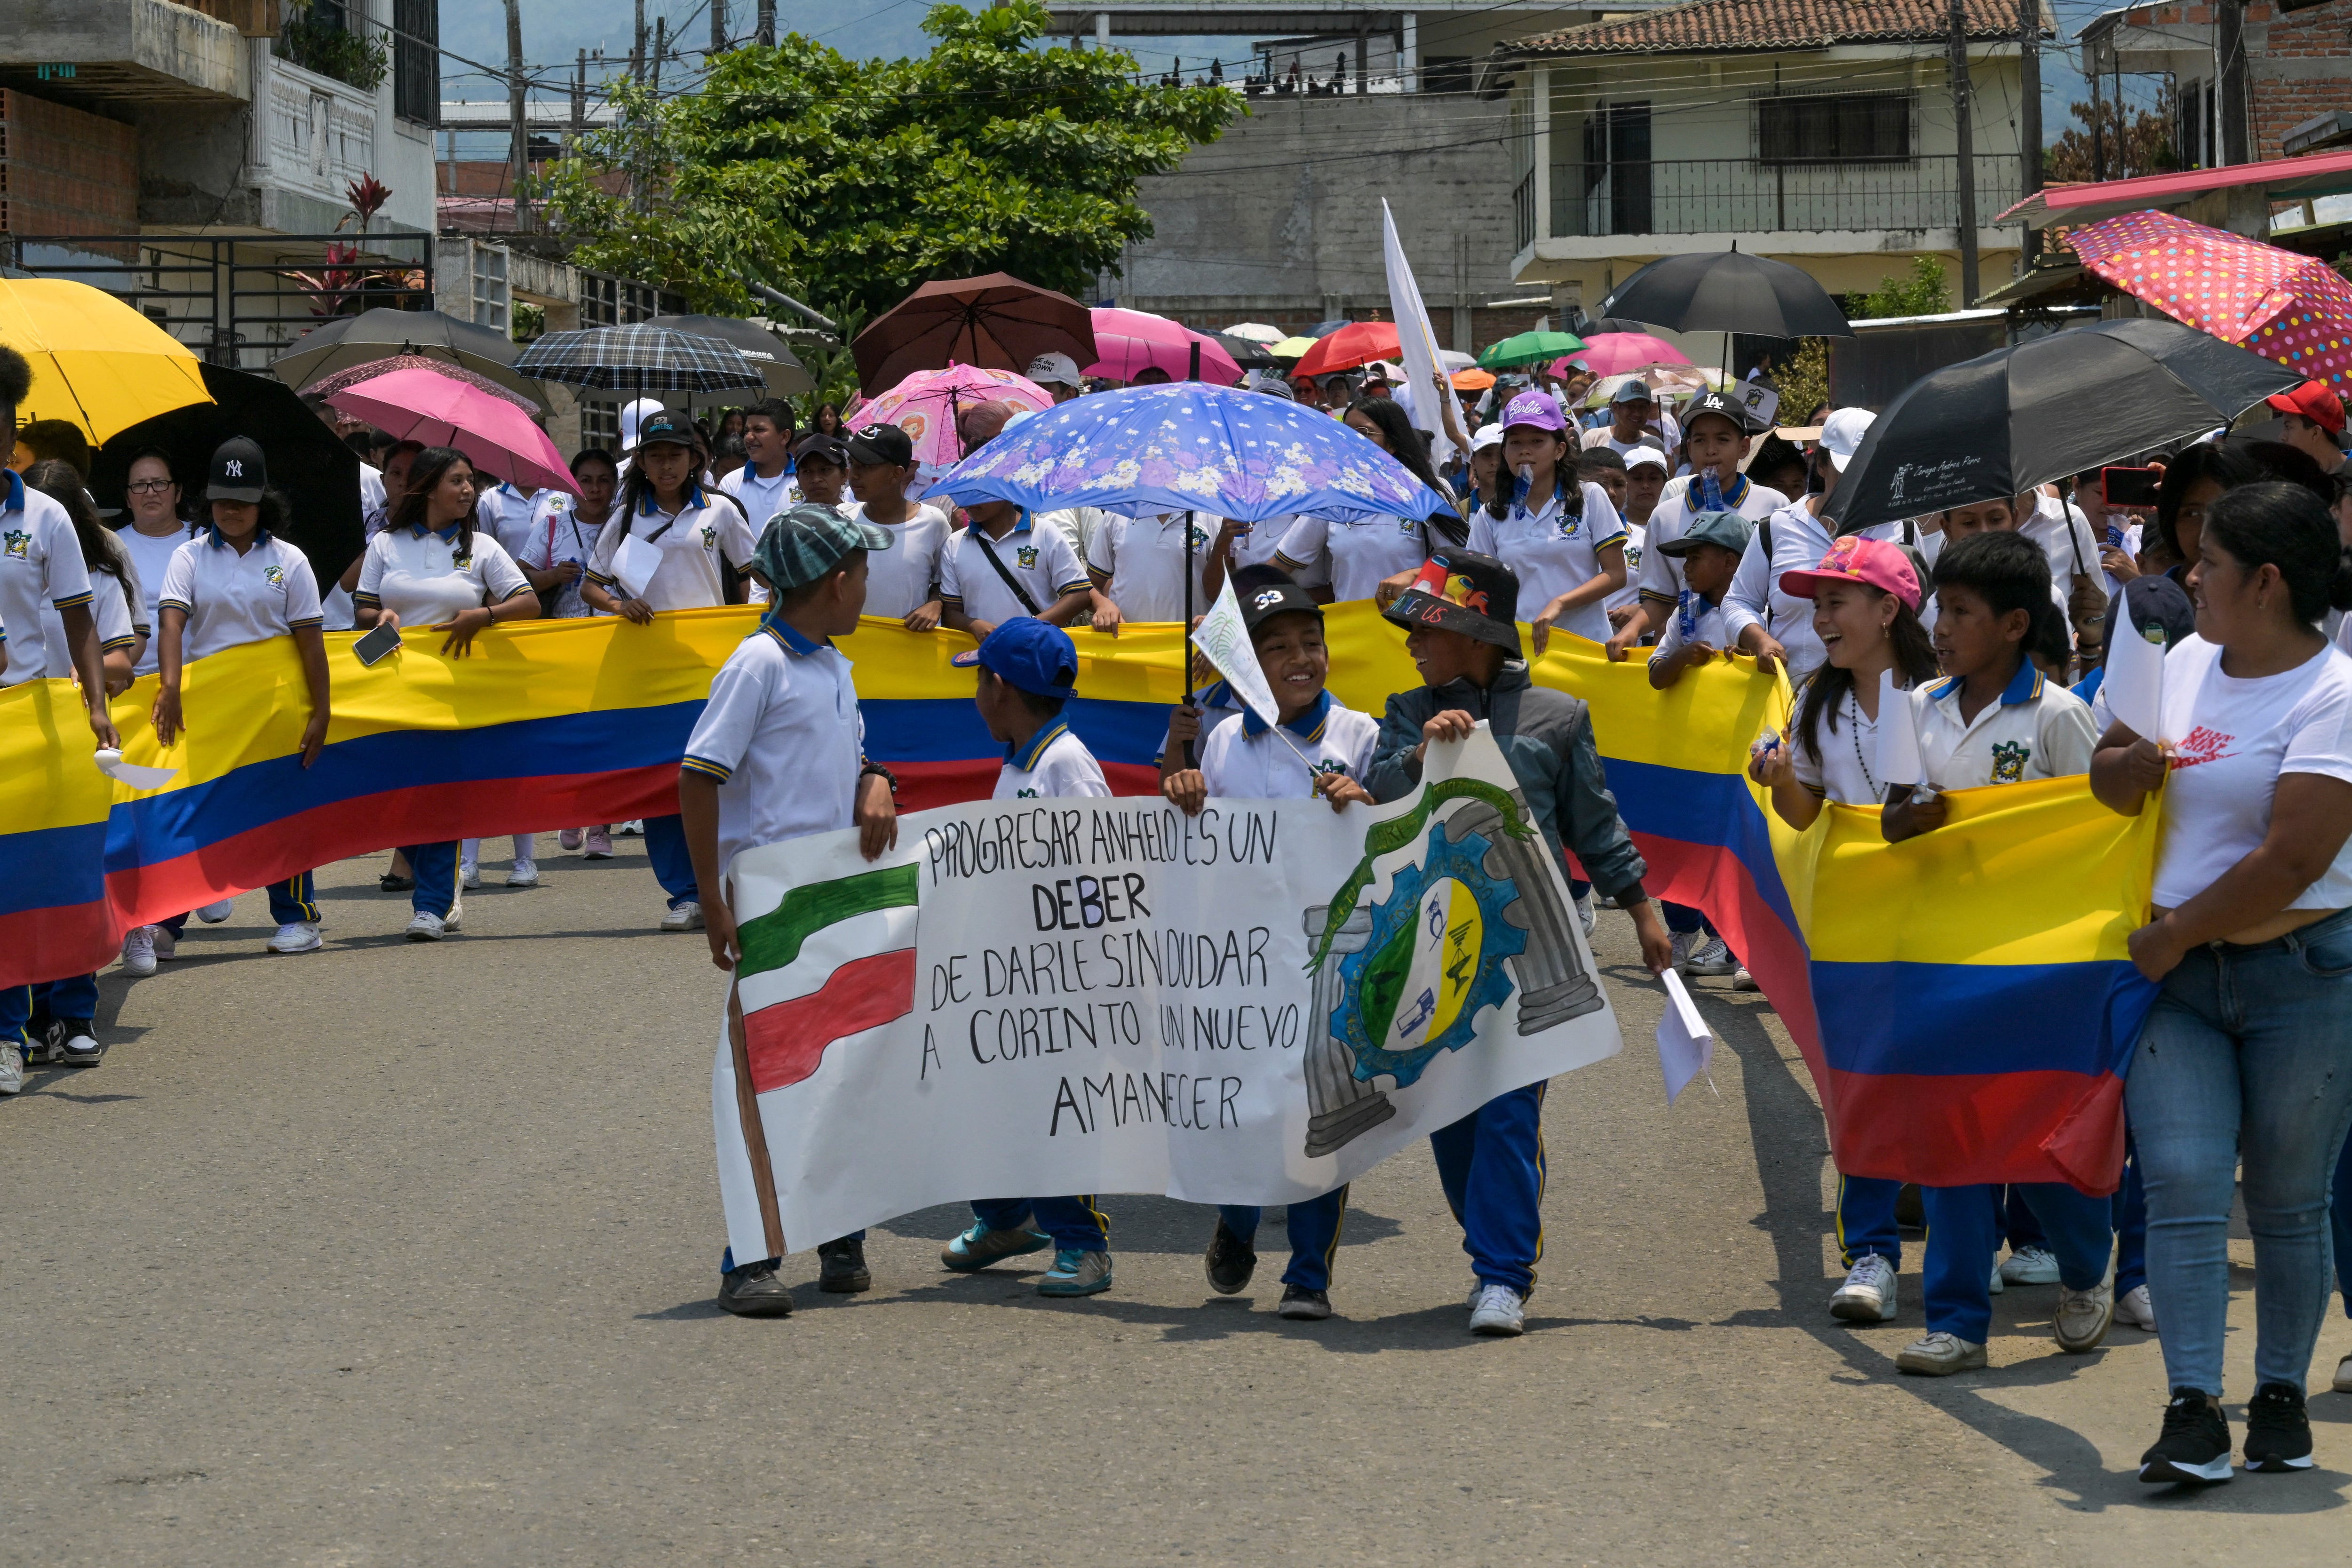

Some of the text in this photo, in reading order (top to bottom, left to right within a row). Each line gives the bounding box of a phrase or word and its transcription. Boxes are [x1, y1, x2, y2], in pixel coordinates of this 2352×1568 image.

[1509, 400, 1544, 420] Barbie
[1703, 393, 1724, 409] LA
[649, 424, 674, 432] CONVERSE
[226, 460, 243, 478] NY
[1938, 460, 1960, 472] Andrea
[1962, 455, 1981, 467] Parra
[1422, 604, 1448, 623] US
[925, 807, 1277, 887] PROGRESAR ANHELO ES UN
[1032, 873, 1151, 932] DEBER
[930, 926, 1270, 1012] DE DARLE SIN DUDAR
[921, 1001, 1300, 1081] A CORINTO UN NUEVO
[1049, 1071, 1243, 1137] AMANECER
